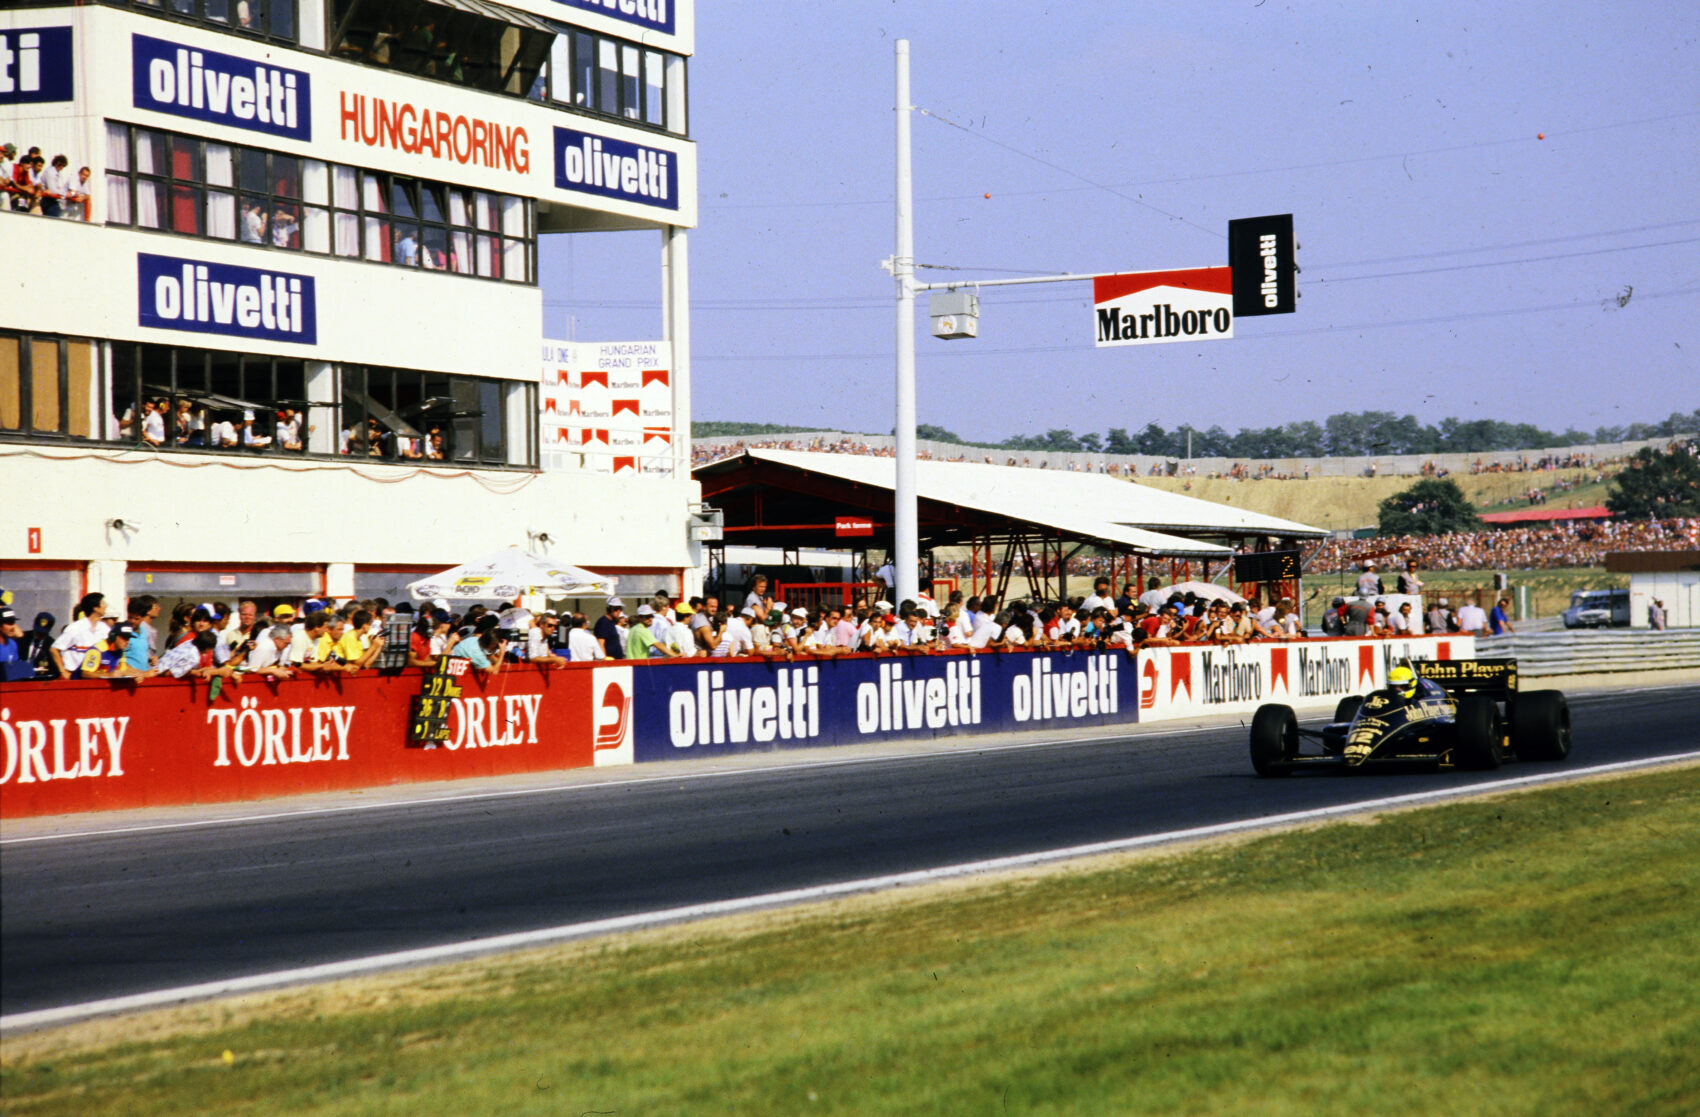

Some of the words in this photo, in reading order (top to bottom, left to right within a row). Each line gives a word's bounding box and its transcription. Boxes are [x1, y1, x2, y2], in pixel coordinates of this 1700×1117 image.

[150, 48, 297, 128] olivetti
[340, 91, 529, 174] HUNGARORING
[565, 137, 667, 200] olivetti
[155, 264, 302, 333] olivetti
[1260, 234, 1278, 309] olivetti
[600, 345, 656, 356] HUNGARIAN
[1097, 305, 1231, 342] Marlboro
[598, 357, 632, 368] GRAND
[637, 357, 659, 368] PRIX
[31, 532, 38, 549] 1
[1281, 556, 1295, 577] 2
[857, 660, 981, 734] olivetti
[1012, 654, 1118, 722] olivetti
[1201, 650, 1261, 704] Marlboro
[1299, 647, 1350, 697] Marlboro
[1420, 663, 1457, 678] John
[207, 696, 355, 767] TÖRLEY
[669, 667, 819, 748] olivetti
